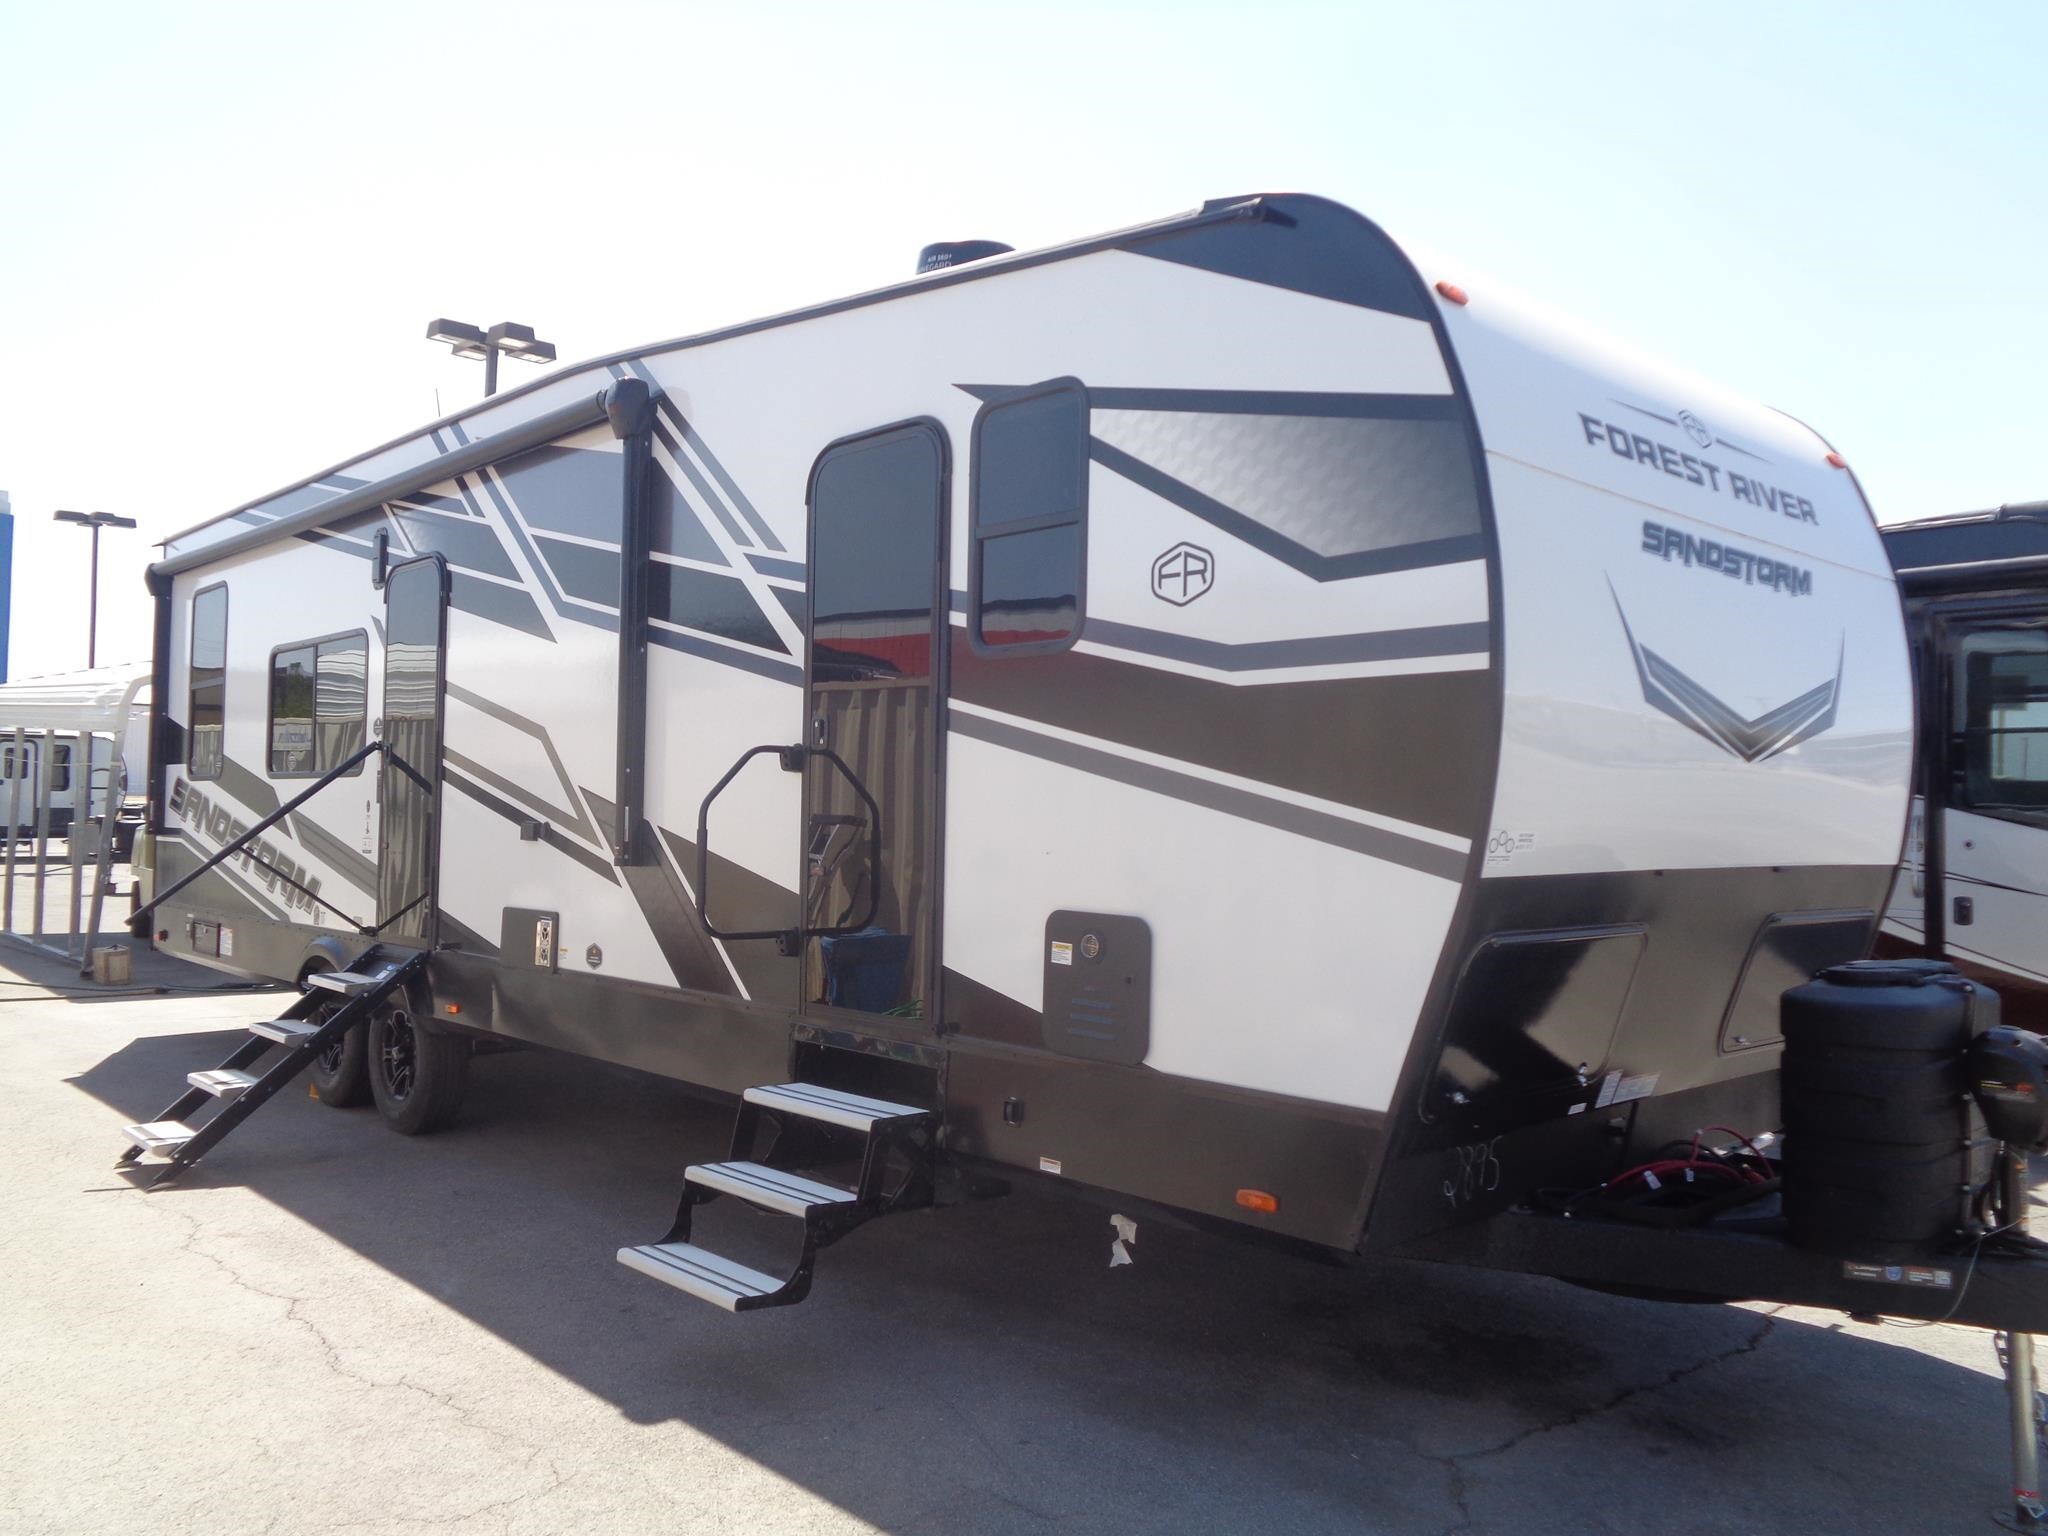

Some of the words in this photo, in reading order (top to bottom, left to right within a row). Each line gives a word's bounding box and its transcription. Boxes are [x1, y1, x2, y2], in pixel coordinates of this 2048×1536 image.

[1577, 412, 1720, 491] FOREST
[1727, 470, 1819, 526] RIVER
[1641, 520, 1813, 597] SANDSTORM
